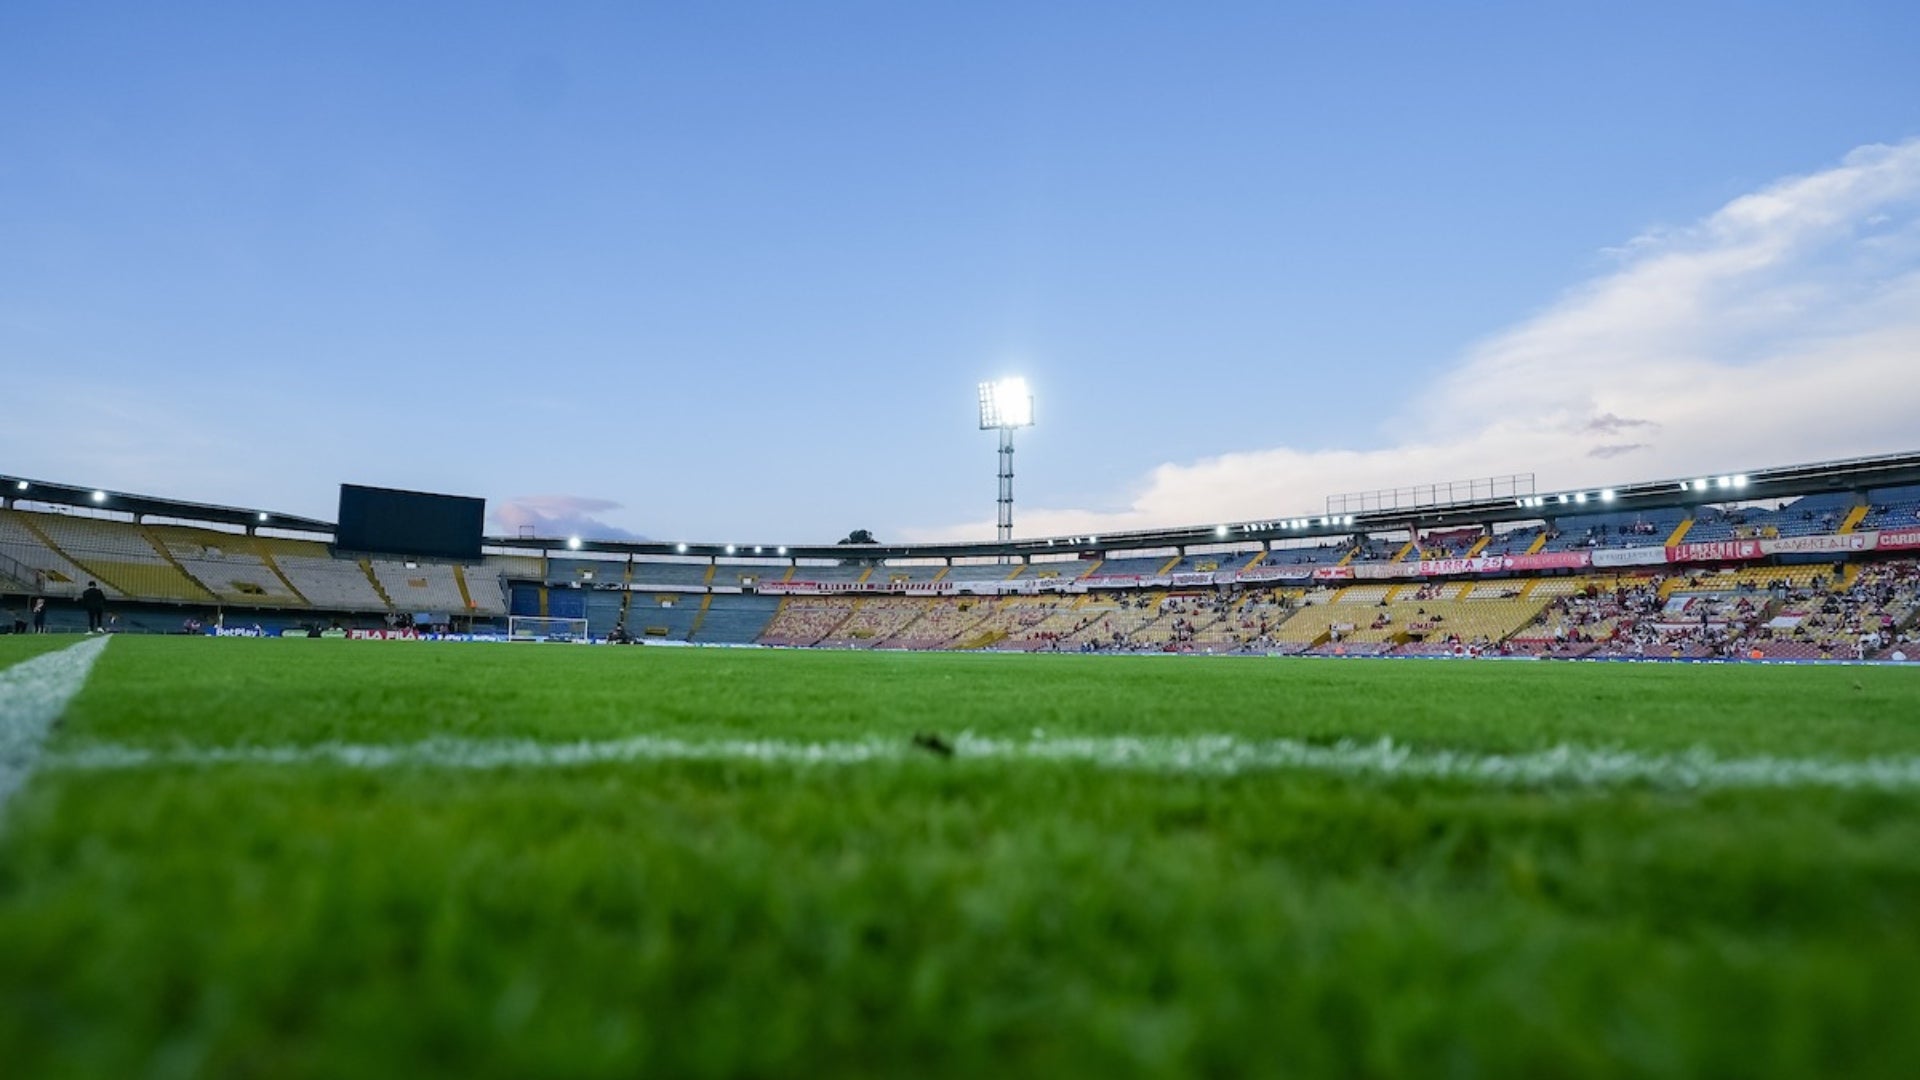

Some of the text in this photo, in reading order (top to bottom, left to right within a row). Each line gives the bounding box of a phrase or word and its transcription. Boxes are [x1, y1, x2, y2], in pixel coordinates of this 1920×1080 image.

[1421, 559, 1474, 571] BARRA
[1482, 558, 1500, 568] 25
[215, 627, 258, 638] BetPlay
[351, 629, 383, 640] FILA
[386, 629, 416, 640] FILA
